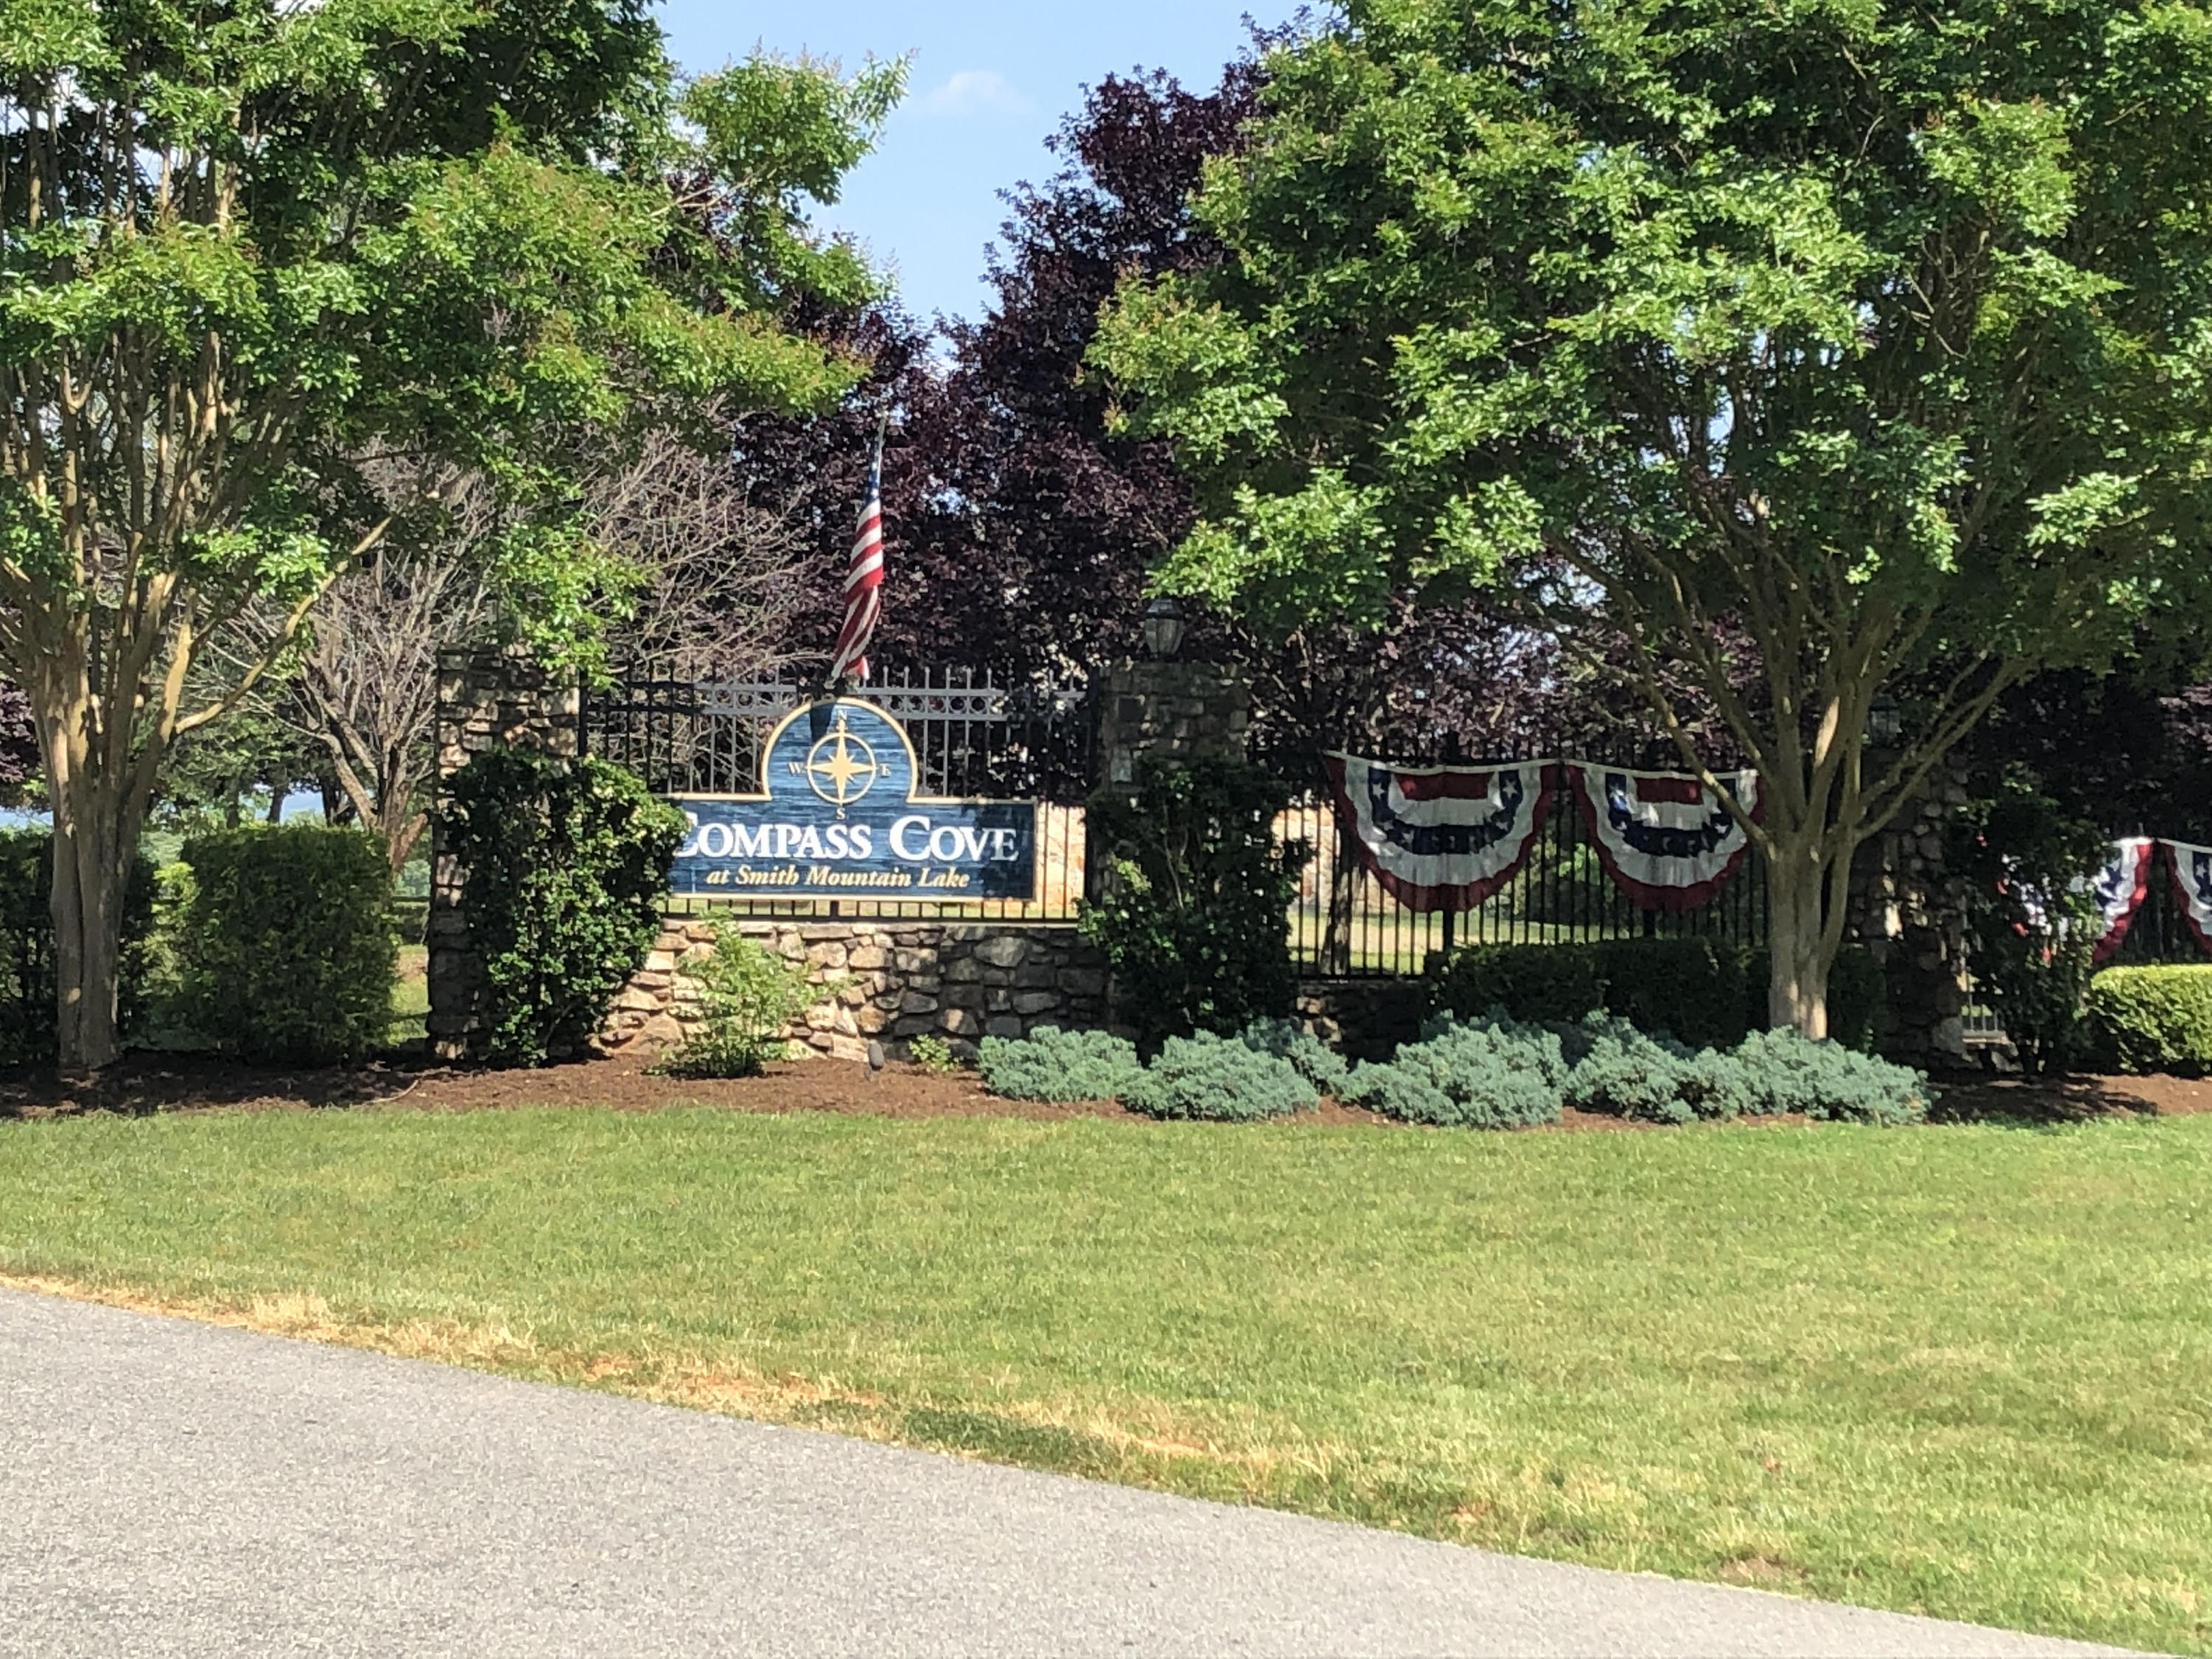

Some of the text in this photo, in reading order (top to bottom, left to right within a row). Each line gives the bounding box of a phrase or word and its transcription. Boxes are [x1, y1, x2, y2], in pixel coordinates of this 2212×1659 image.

[837, 709, 847, 720] N
[788, 762, 802, 776] W
[881, 763, 891, 777] E
[836, 808, 845, 820] S
[888, 815, 1018, 861] COVE
[706, 865, 970, 888] at Smith Mountain Lake
